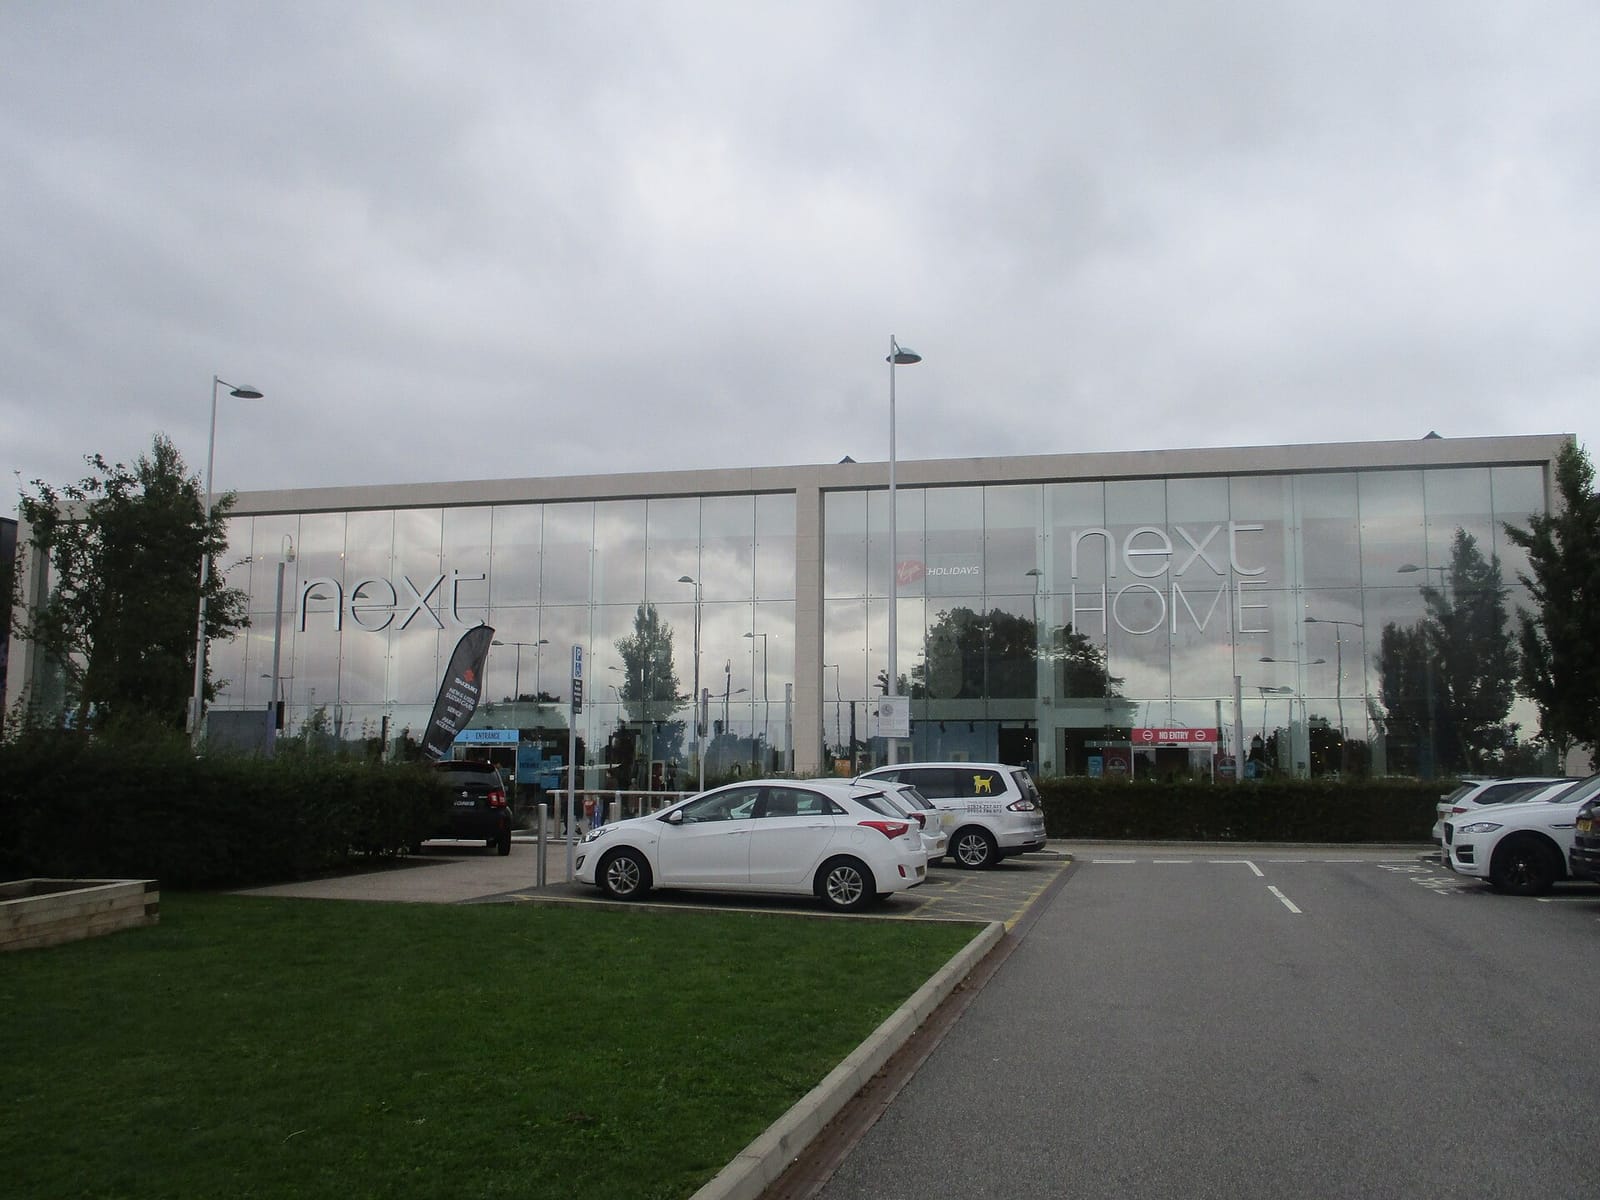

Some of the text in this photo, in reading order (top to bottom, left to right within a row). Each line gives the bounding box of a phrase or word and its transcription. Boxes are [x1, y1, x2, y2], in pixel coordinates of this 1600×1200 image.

[1071, 520, 1267, 579] next
[927, 566, 980, 576] HOLIDAYS
[298, 569, 486, 633] next
[1071, 581, 1270, 635] HOME
[455, 677, 479, 695] SUZUKI
[476, 732, 500, 740] ENTRANCE
[1159, 731, 1189, 740] NO ENTRY
